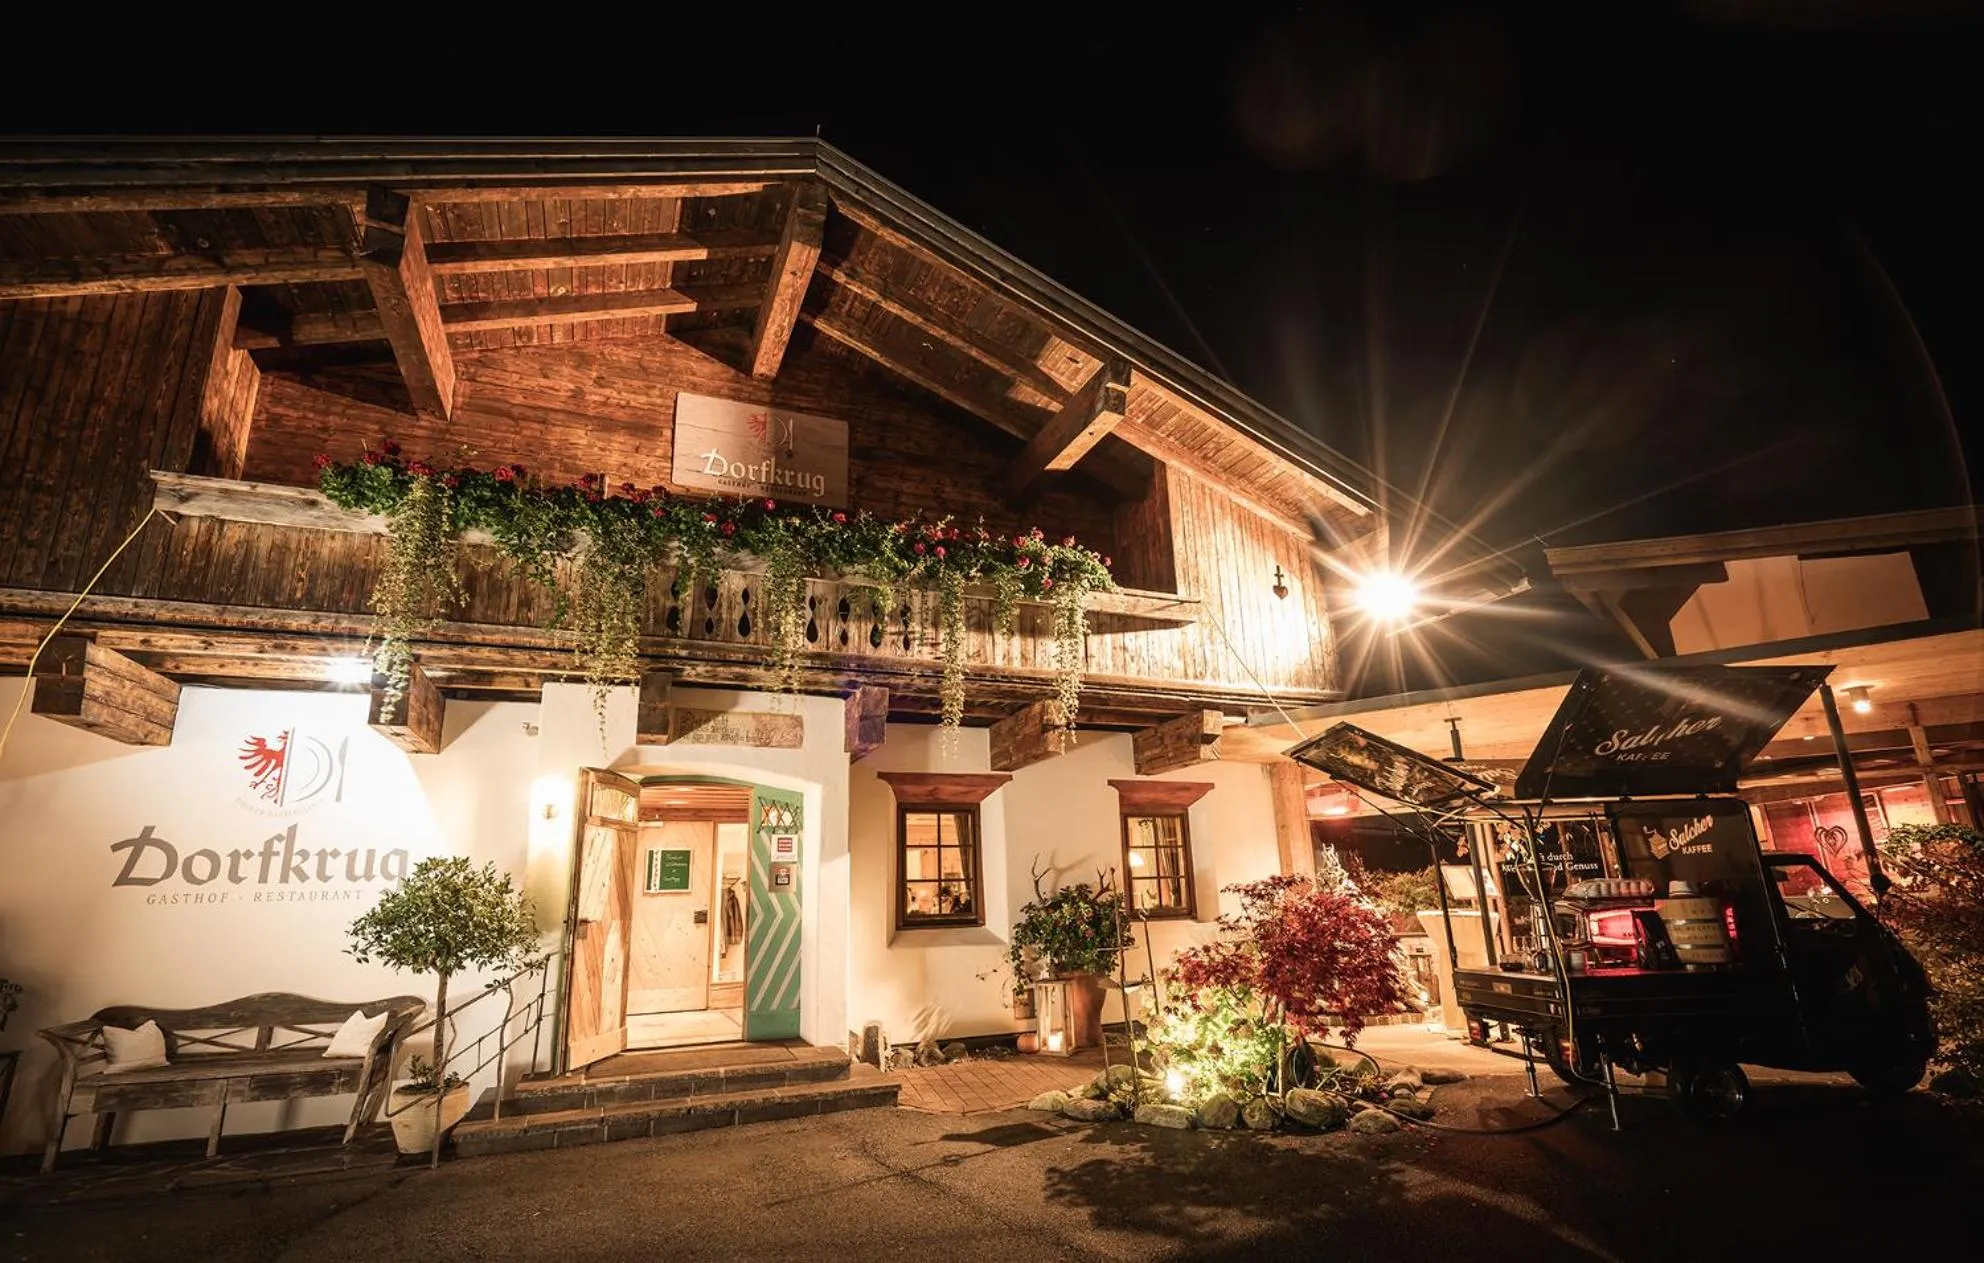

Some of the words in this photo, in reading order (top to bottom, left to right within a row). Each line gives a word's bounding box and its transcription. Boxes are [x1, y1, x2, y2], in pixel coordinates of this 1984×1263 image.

[701, 448, 825, 497] Dorfkrug
[1669, 815, 1713, 850] Salcher
[1682, 844, 1713, 855] KAFFEE
[1546, 852, 1574, 861] durch
[1565, 862, 1599, 871] Genuss
[146, 892, 229, 905] GASTHOF
[253, 890, 365, 902] RESTAURANT
